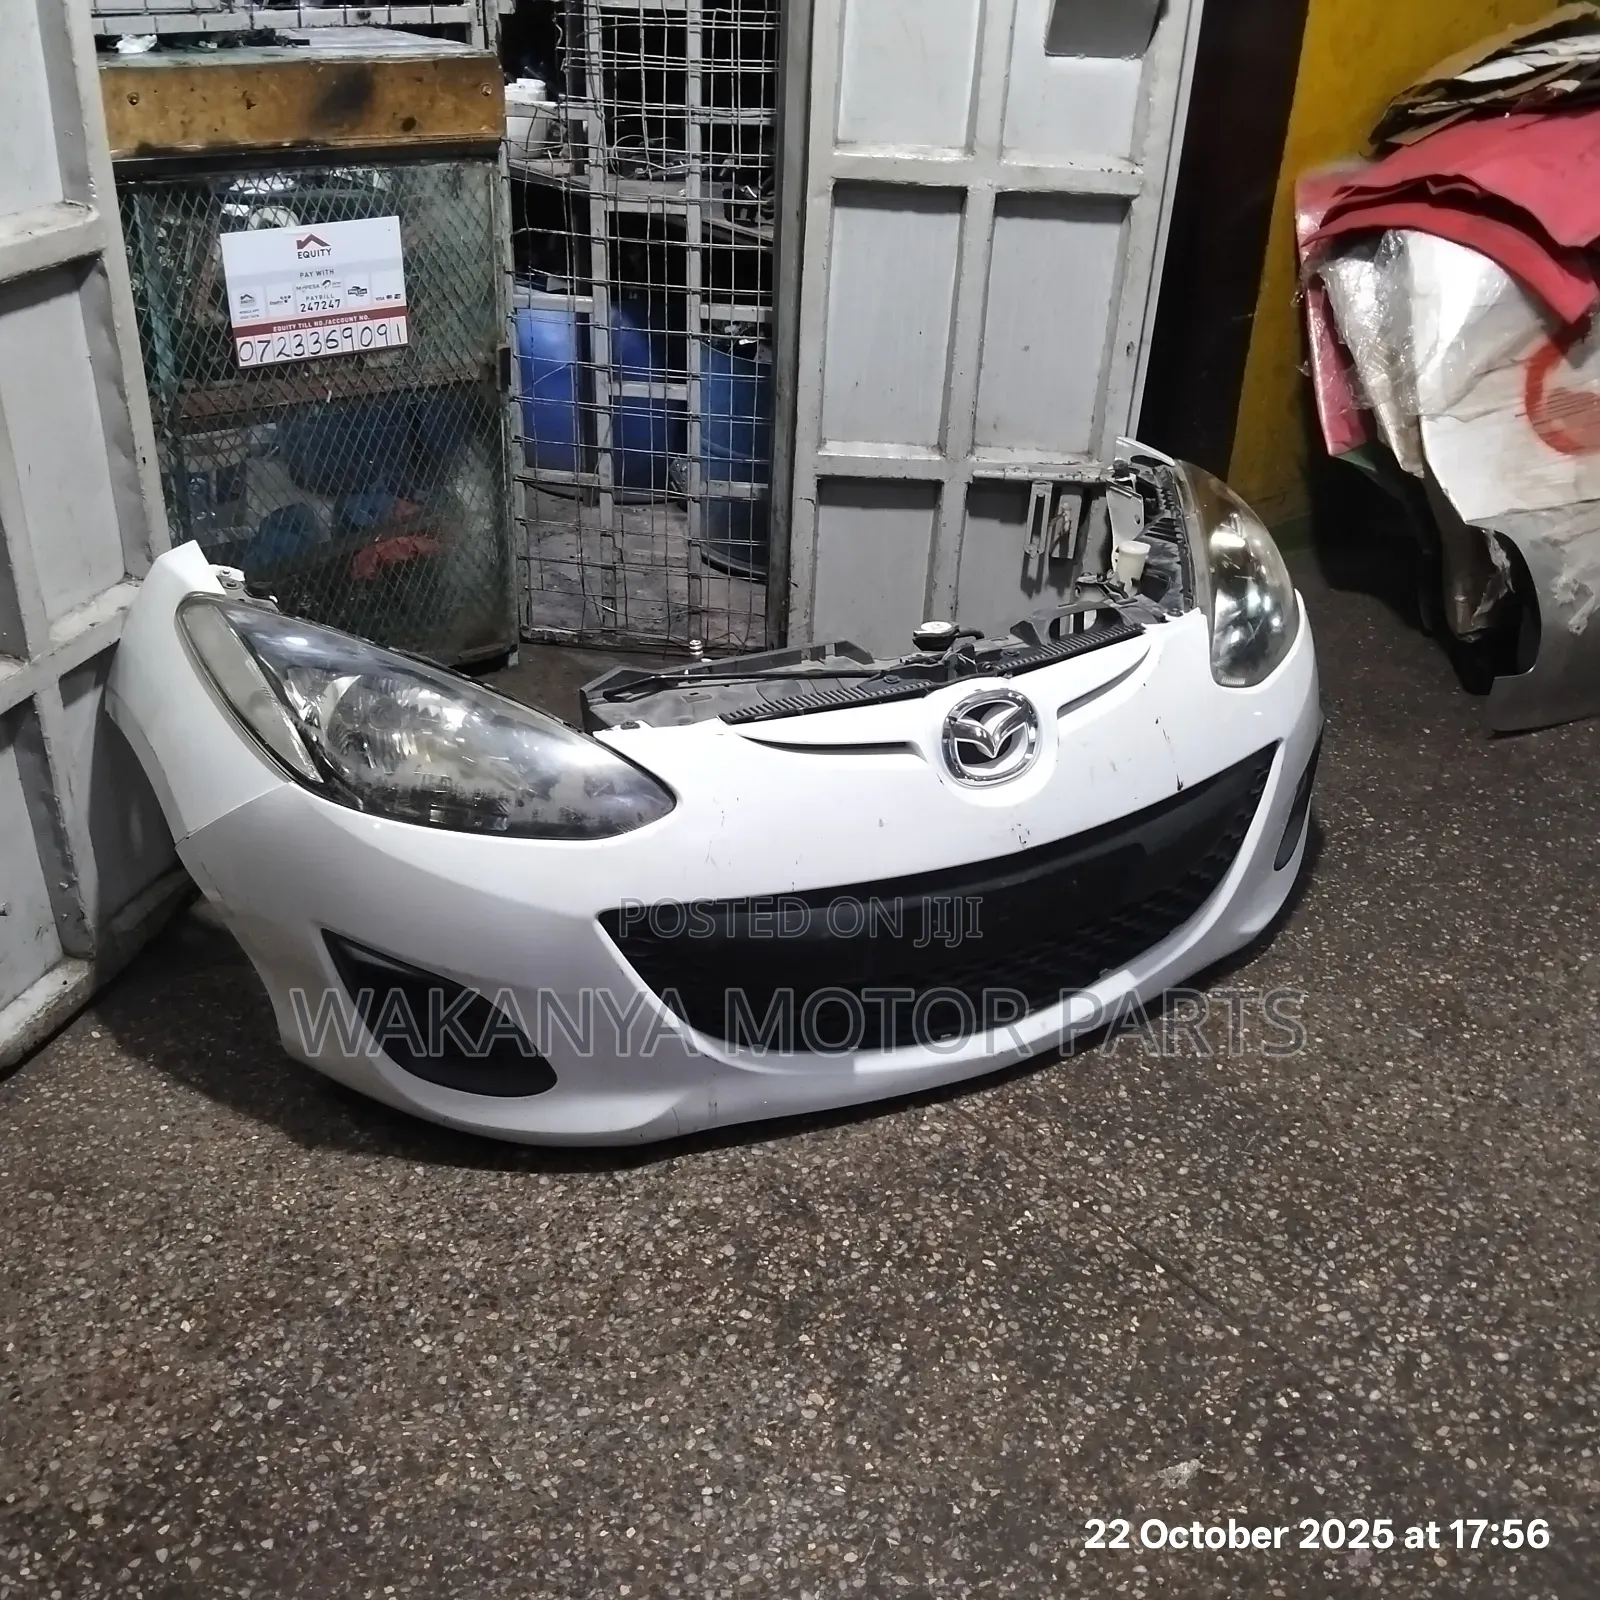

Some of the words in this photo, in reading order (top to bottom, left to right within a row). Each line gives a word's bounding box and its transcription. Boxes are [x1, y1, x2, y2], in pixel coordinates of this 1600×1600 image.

[297, 248, 332, 259] EQUITY
[316, 269, 335, 277] WITH
[300, 298, 341, 313] 247247
[272, 324, 297, 333] EQUITY
[238, 323, 402, 362] 0723369091
